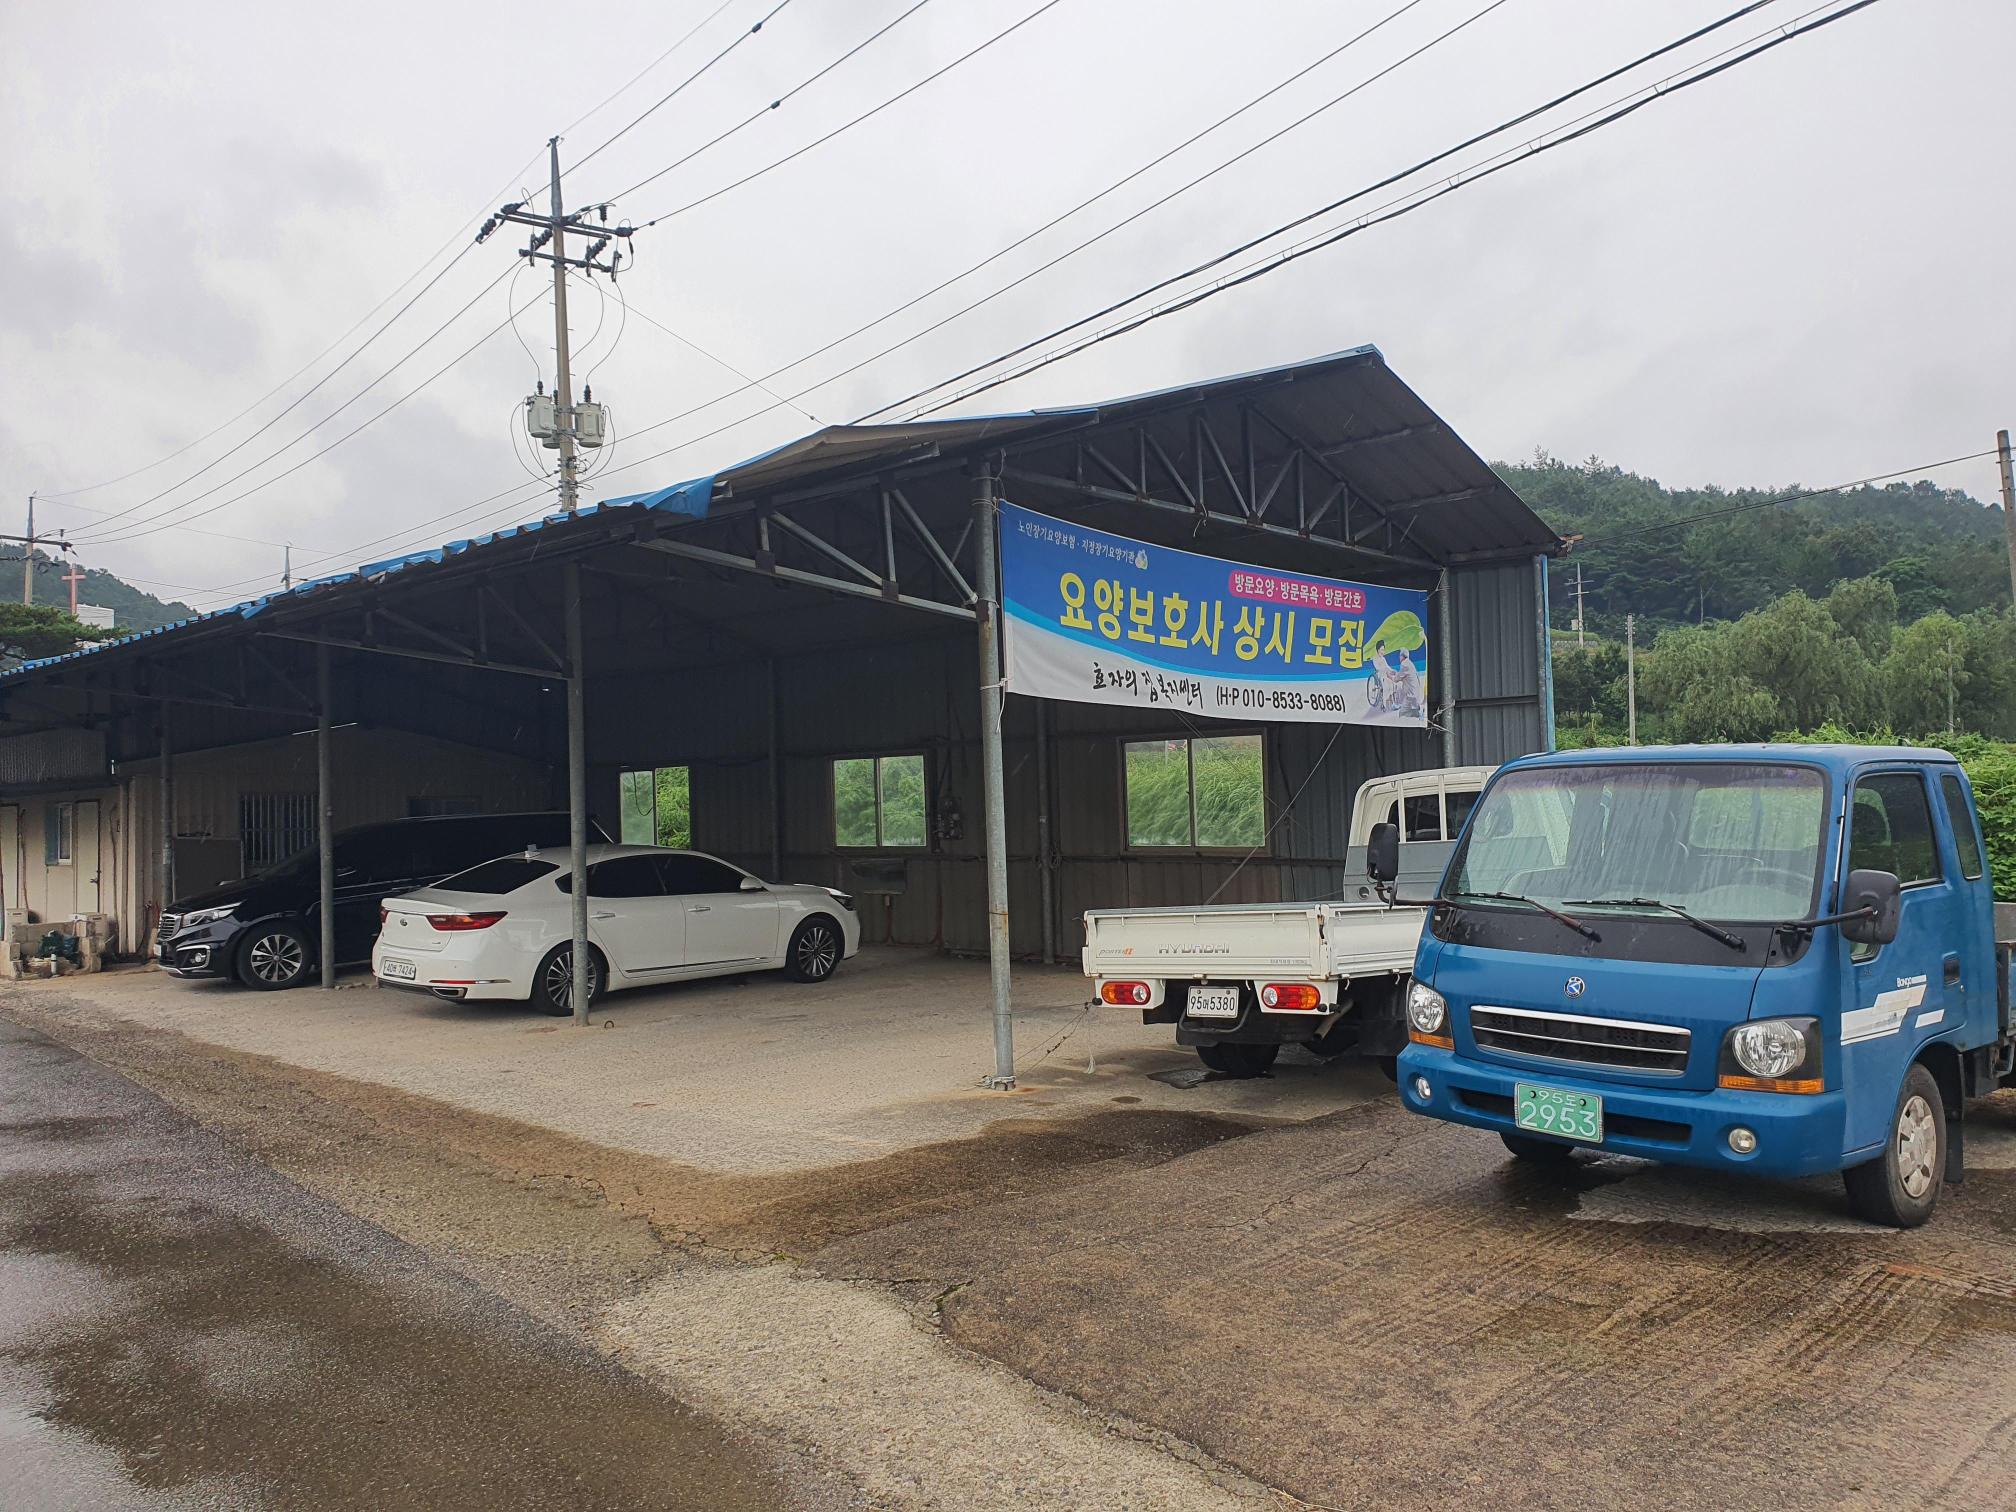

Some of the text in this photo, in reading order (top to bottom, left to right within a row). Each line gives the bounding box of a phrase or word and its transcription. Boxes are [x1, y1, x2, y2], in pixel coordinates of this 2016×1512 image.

[1059, 572, 1366, 669] 요양보호사 상시 모집
[1242, 688, 1346, 713] 010-8533-8088)
[1158, 943, 1230, 954] HYUNDAI
[1520, 1101, 1597, 1137] 2953
